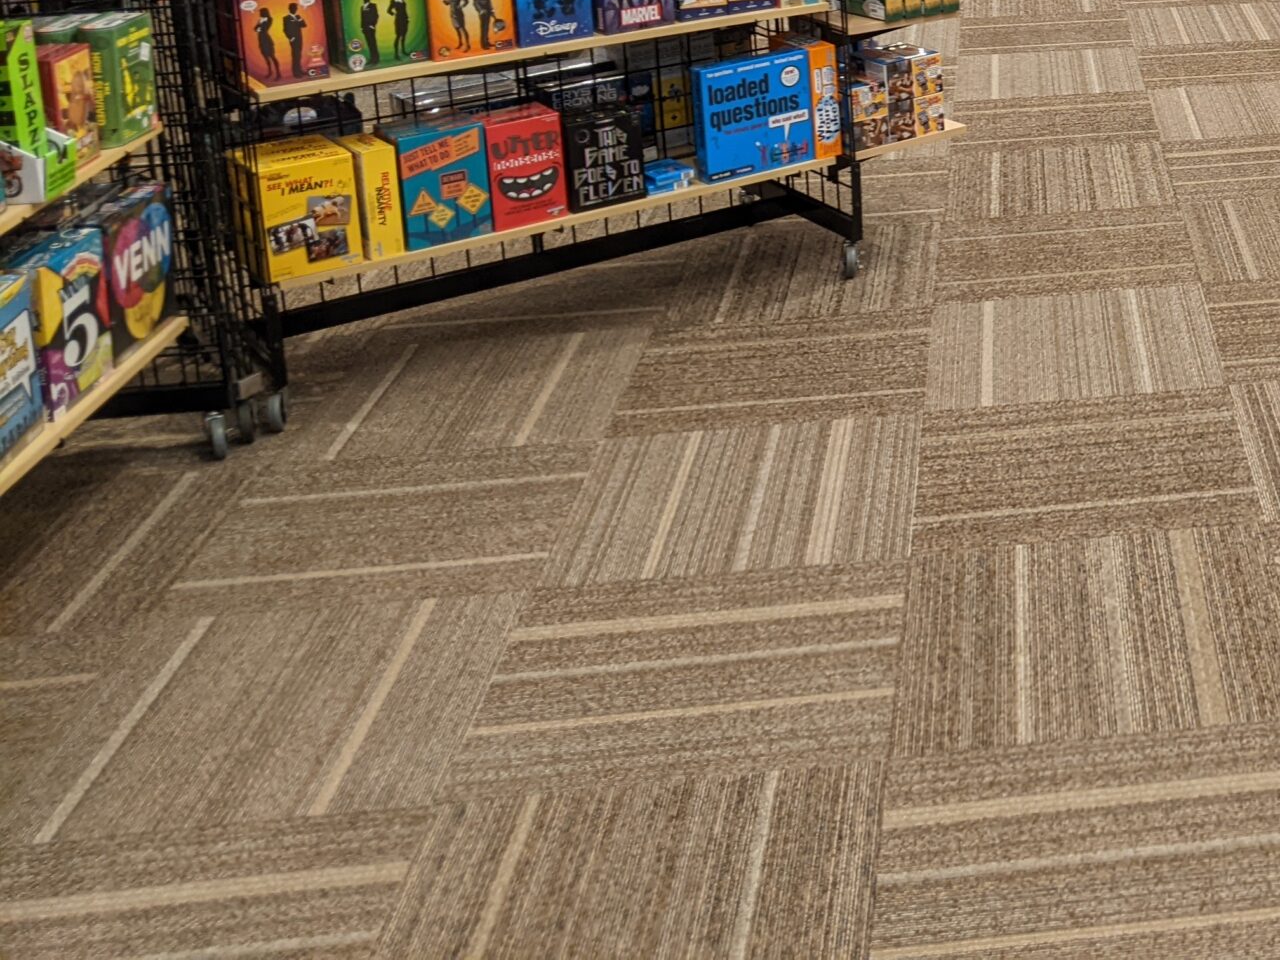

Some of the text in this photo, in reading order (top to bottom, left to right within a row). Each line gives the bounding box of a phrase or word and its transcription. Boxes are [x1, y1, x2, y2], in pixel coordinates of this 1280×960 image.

[620, 4, 662, 25] MARVEL
[551, 83, 617, 100] CRYSAL
[552, 91, 617, 110] GROWNG
[707, 72, 770, 106] loaded
[709, 93, 800, 133] questions
[408, 149, 450, 173] WHAT TO DO
[420, 145, 438, 157] TELL
[438, 140, 450, 153] ME
[584, 144, 631, 170] GAME
[266, 175, 314, 192] SEE WHAT
[573, 159, 641, 190] GOES TO
[113, 220, 171, 290] VENN
[63, 283, 100, 368] 5
